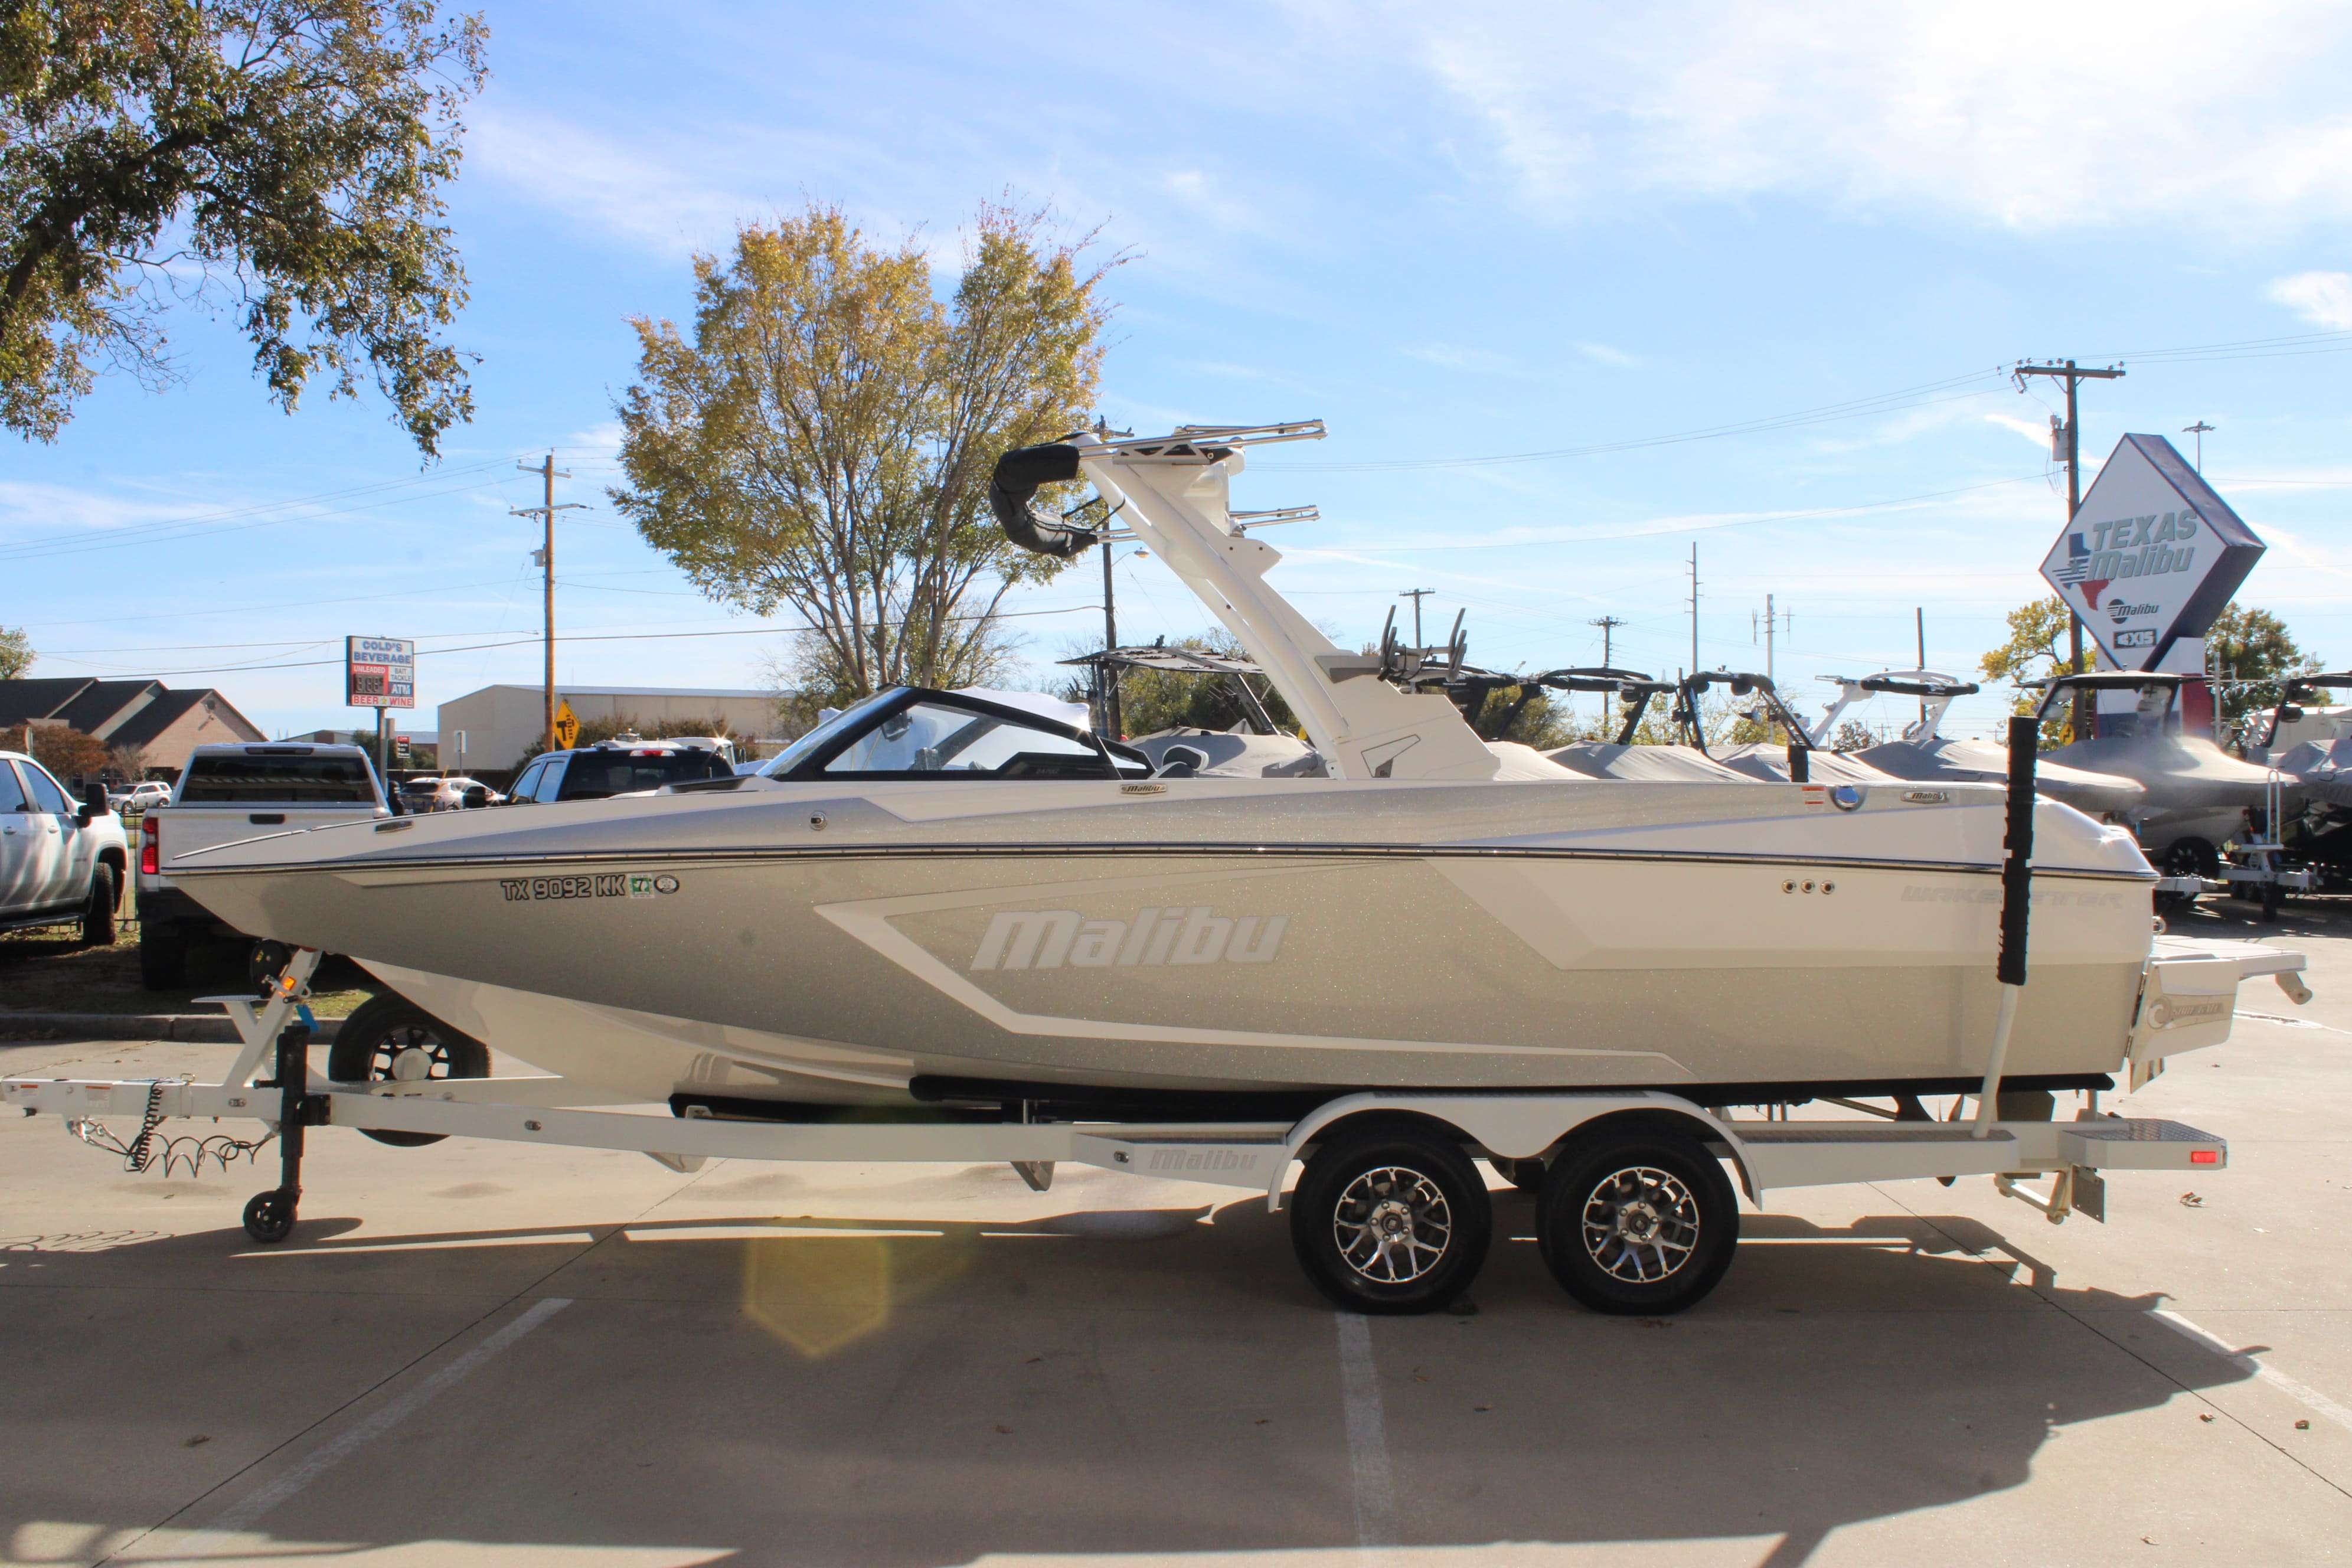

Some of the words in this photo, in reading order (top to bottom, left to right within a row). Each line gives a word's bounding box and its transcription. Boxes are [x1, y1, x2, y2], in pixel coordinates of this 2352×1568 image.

[2093, 509, 2197, 551] TEXAS
[2085, 544, 2195, 582] Malibu
[2116, 603, 2160, 616] Malibu
[354, 651, 412, 664] BEVERAGE
[354, 665, 386, 673] UNLEADED
[391, 684, 411, 695] ATM
[354, 696, 379, 705] BEER
[390, 697, 413, 706] WINE
[501, 880, 530, 901] TX
[533, 877, 592, 900] 9092
[596, 874, 626, 897] KK
[969, 906, 1291, 971] Malibu
[1149, 1149, 1257, 1171] Malibu
